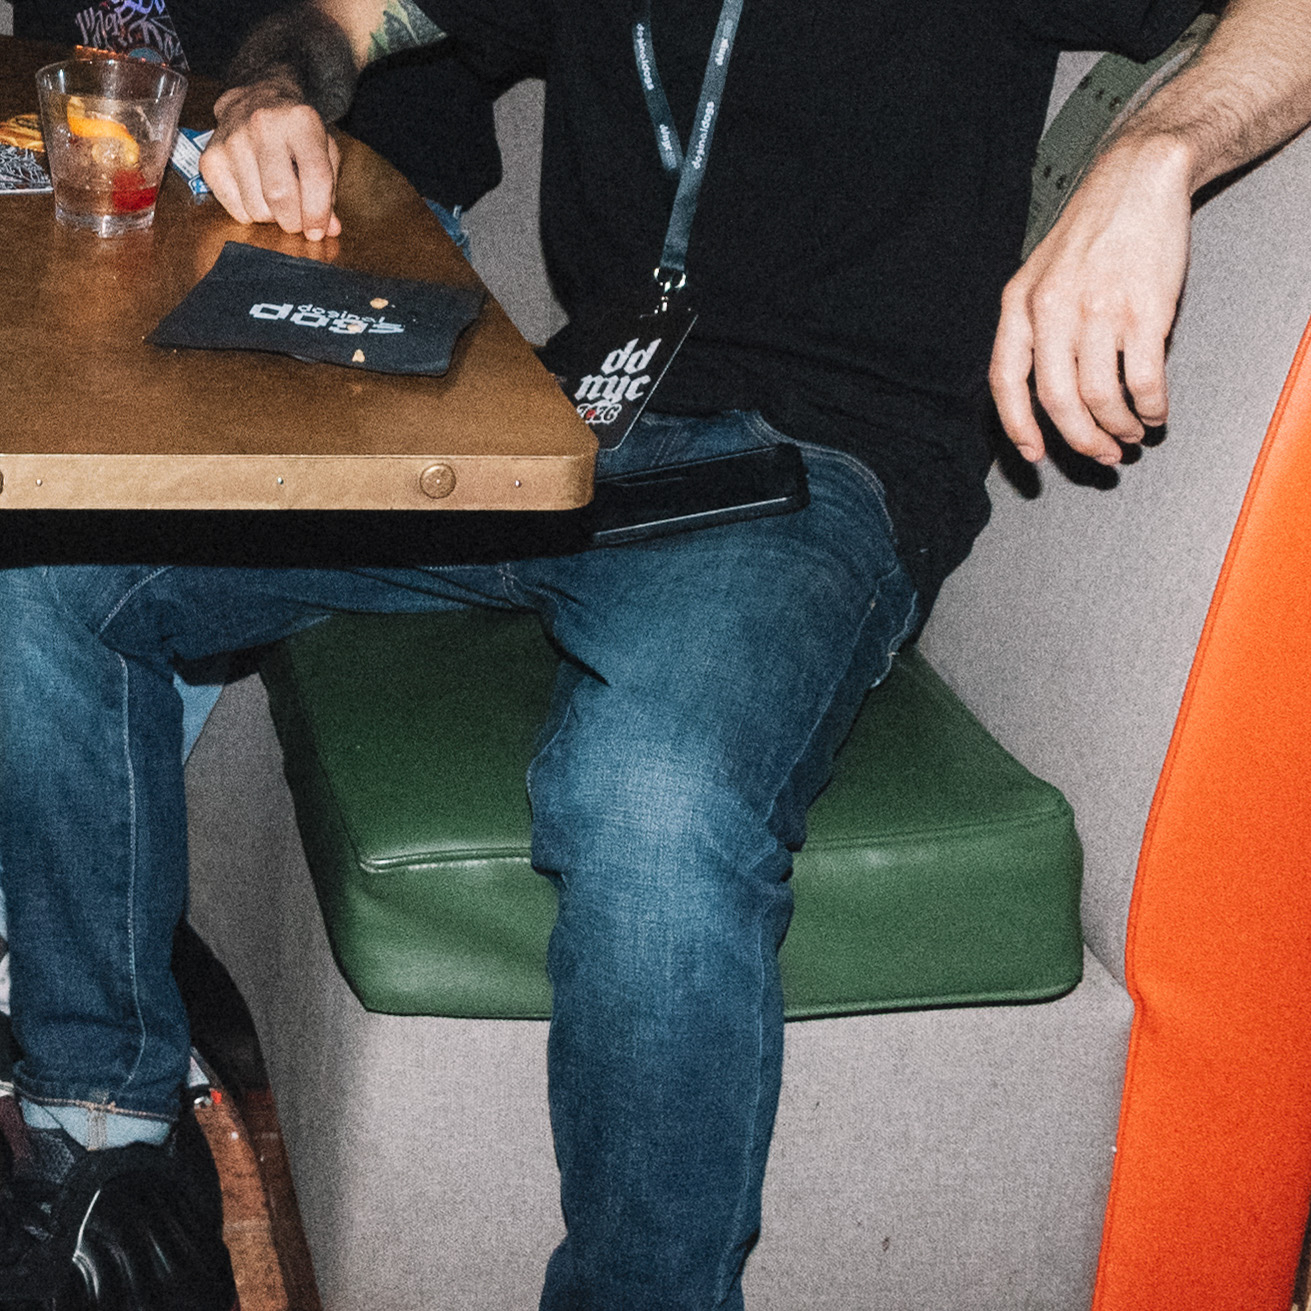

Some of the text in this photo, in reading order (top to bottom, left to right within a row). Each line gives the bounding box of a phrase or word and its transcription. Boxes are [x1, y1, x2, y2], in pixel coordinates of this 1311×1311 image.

[249, 302, 405, 334] dogs
[600, 337, 662, 375] dd
[574, 374, 651, 404] nyc
